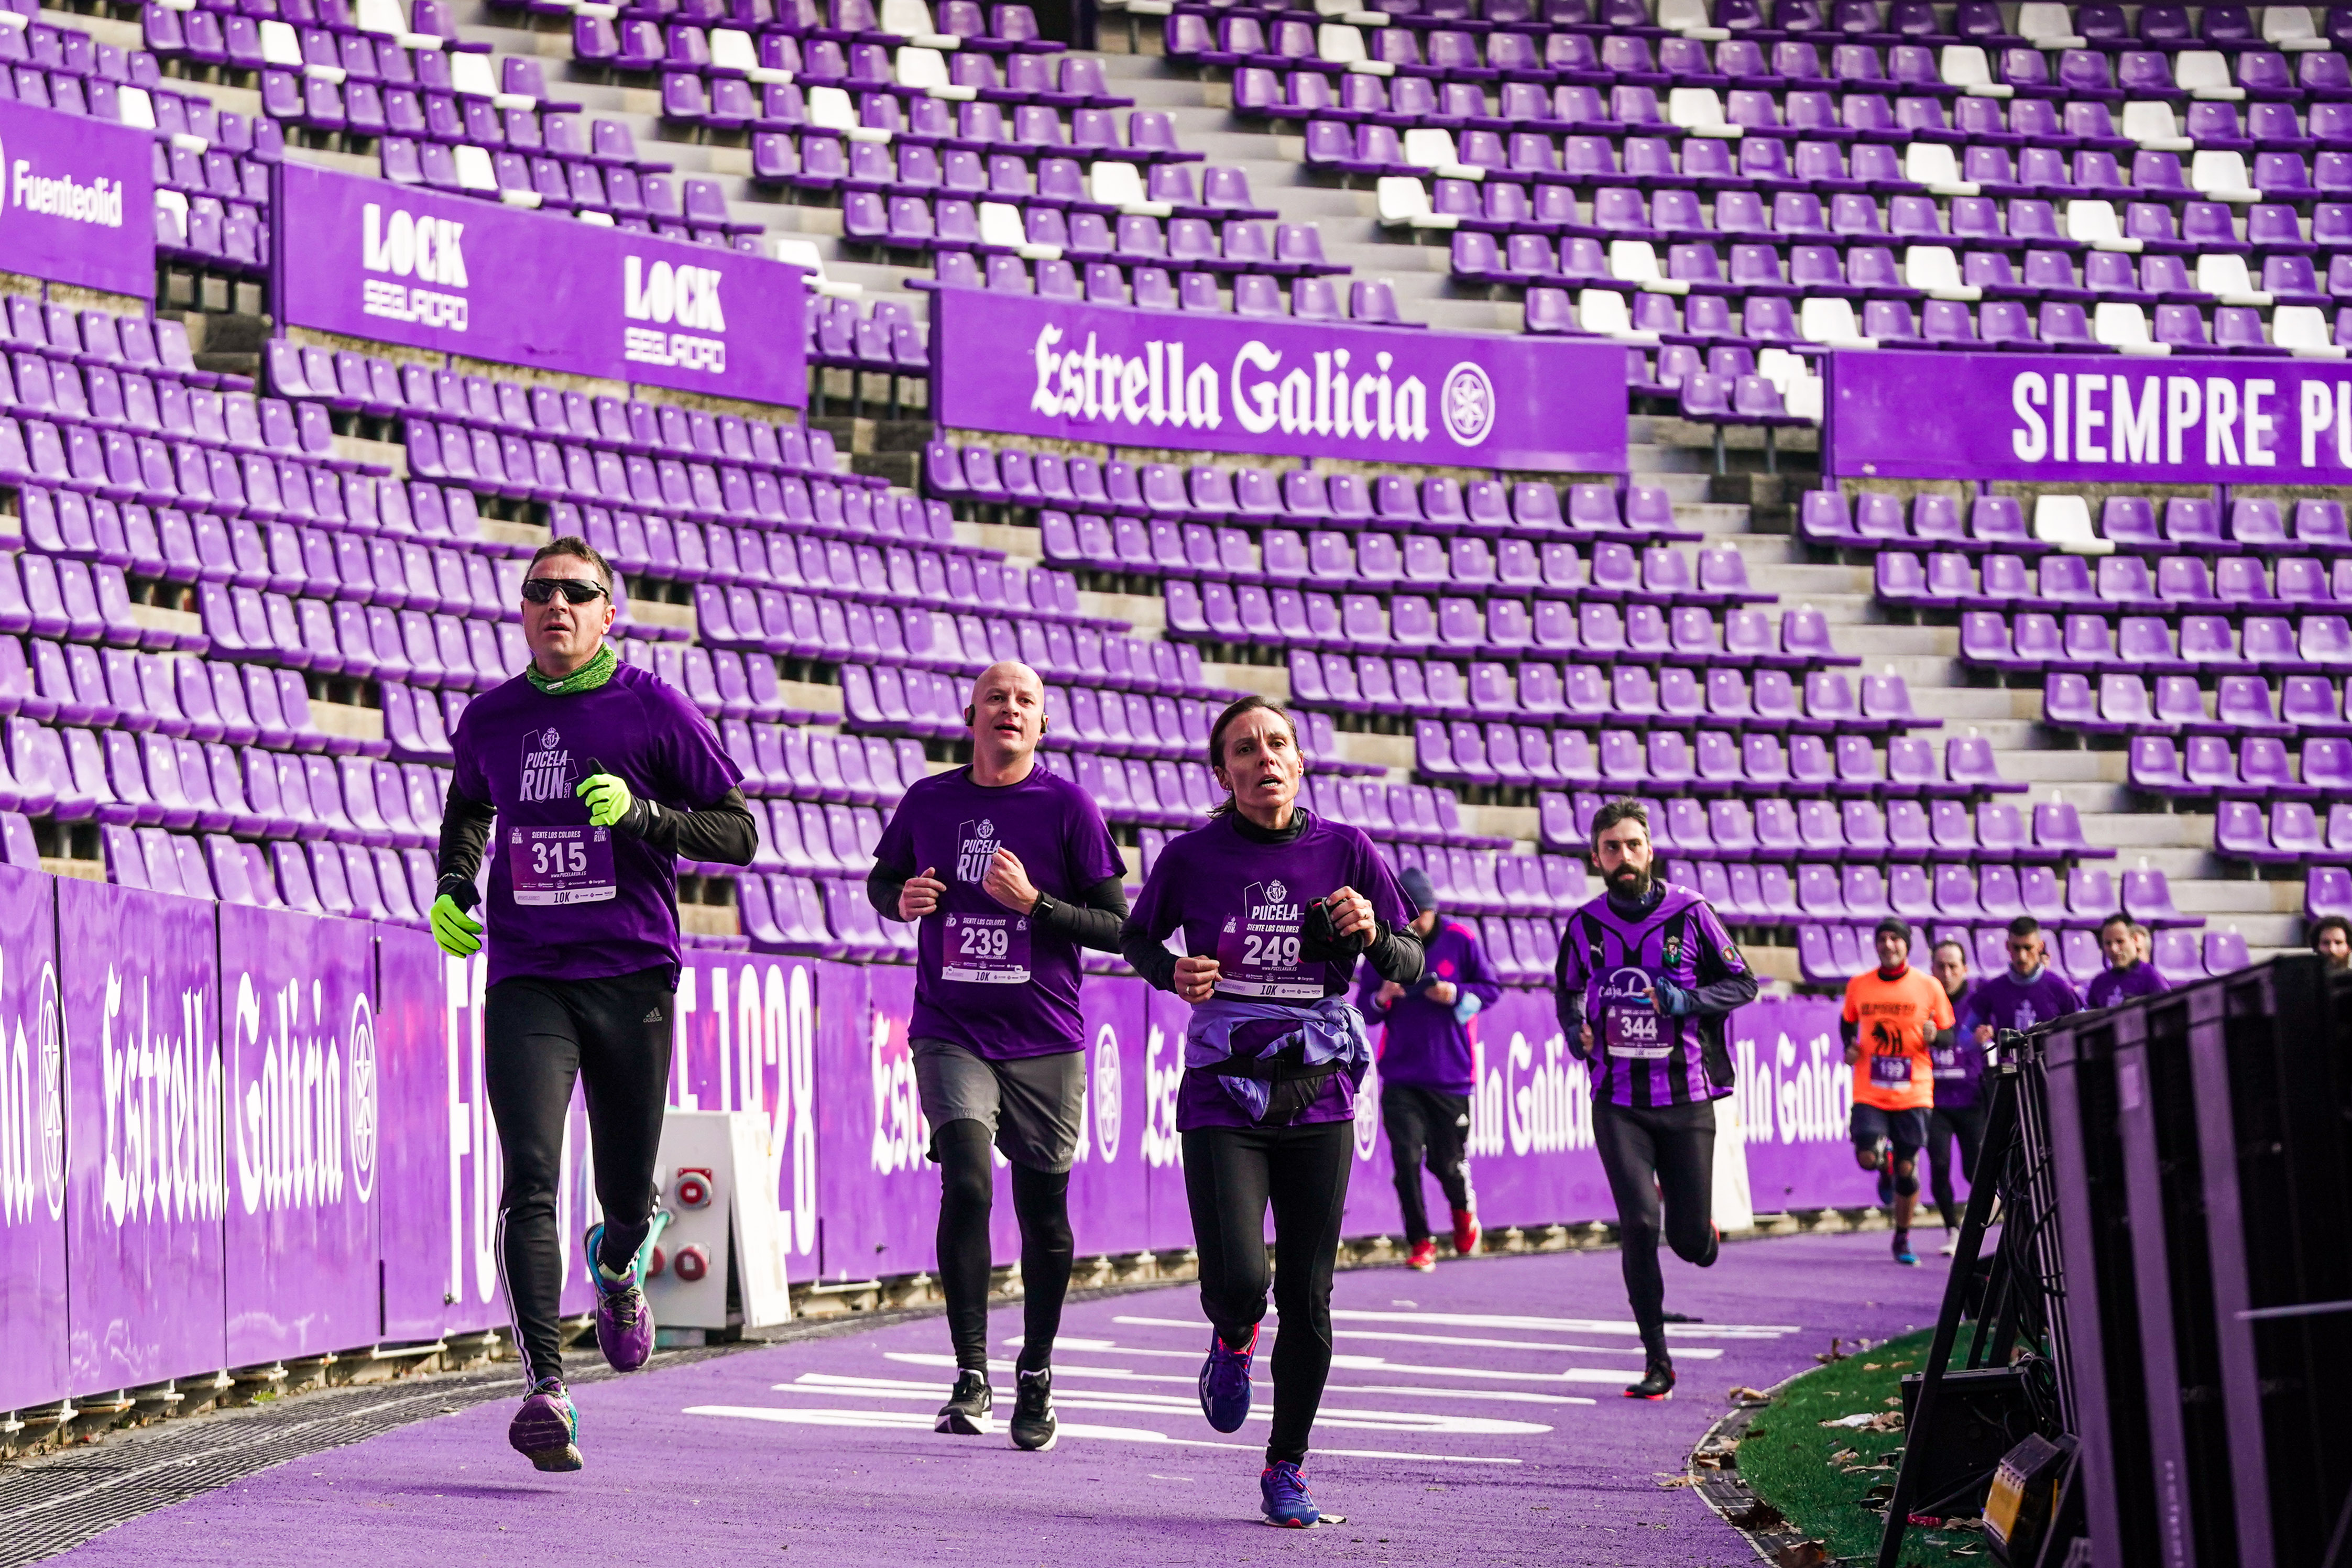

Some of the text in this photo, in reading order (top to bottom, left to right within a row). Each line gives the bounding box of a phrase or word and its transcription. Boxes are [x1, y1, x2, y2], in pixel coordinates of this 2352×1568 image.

[13, 159, 123, 228] Fuenteolid
[363, 203, 469, 289] LOCK
[624, 255, 726, 333] LOCK
[1030, 323, 1429, 442] Estrella Galicia
[2012, 371, 2276, 467] SIEMPRE
[525, 750, 568, 769] PUCELA
[519, 767, 566, 802] RUN
[531, 842, 587, 874] 315
[961, 839, 1001, 853] PUCELA
[554, 892, 571, 903] 10K
[1252, 904, 1298, 920] PUCELA
[960, 927, 1008, 956] 239
[1246, 923, 1265, 932] SIENTE
[1276, 925, 1300, 933] COLORES
[1242, 935, 1301, 966] 249
[975, 972, 990, 981] 10K
[1260, 985, 1278, 995] 10K
[1621, 1016, 1658, 1039] 344
[104, 960, 229, 1228] Estrella
[234, 971, 344, 1215] Galicia
